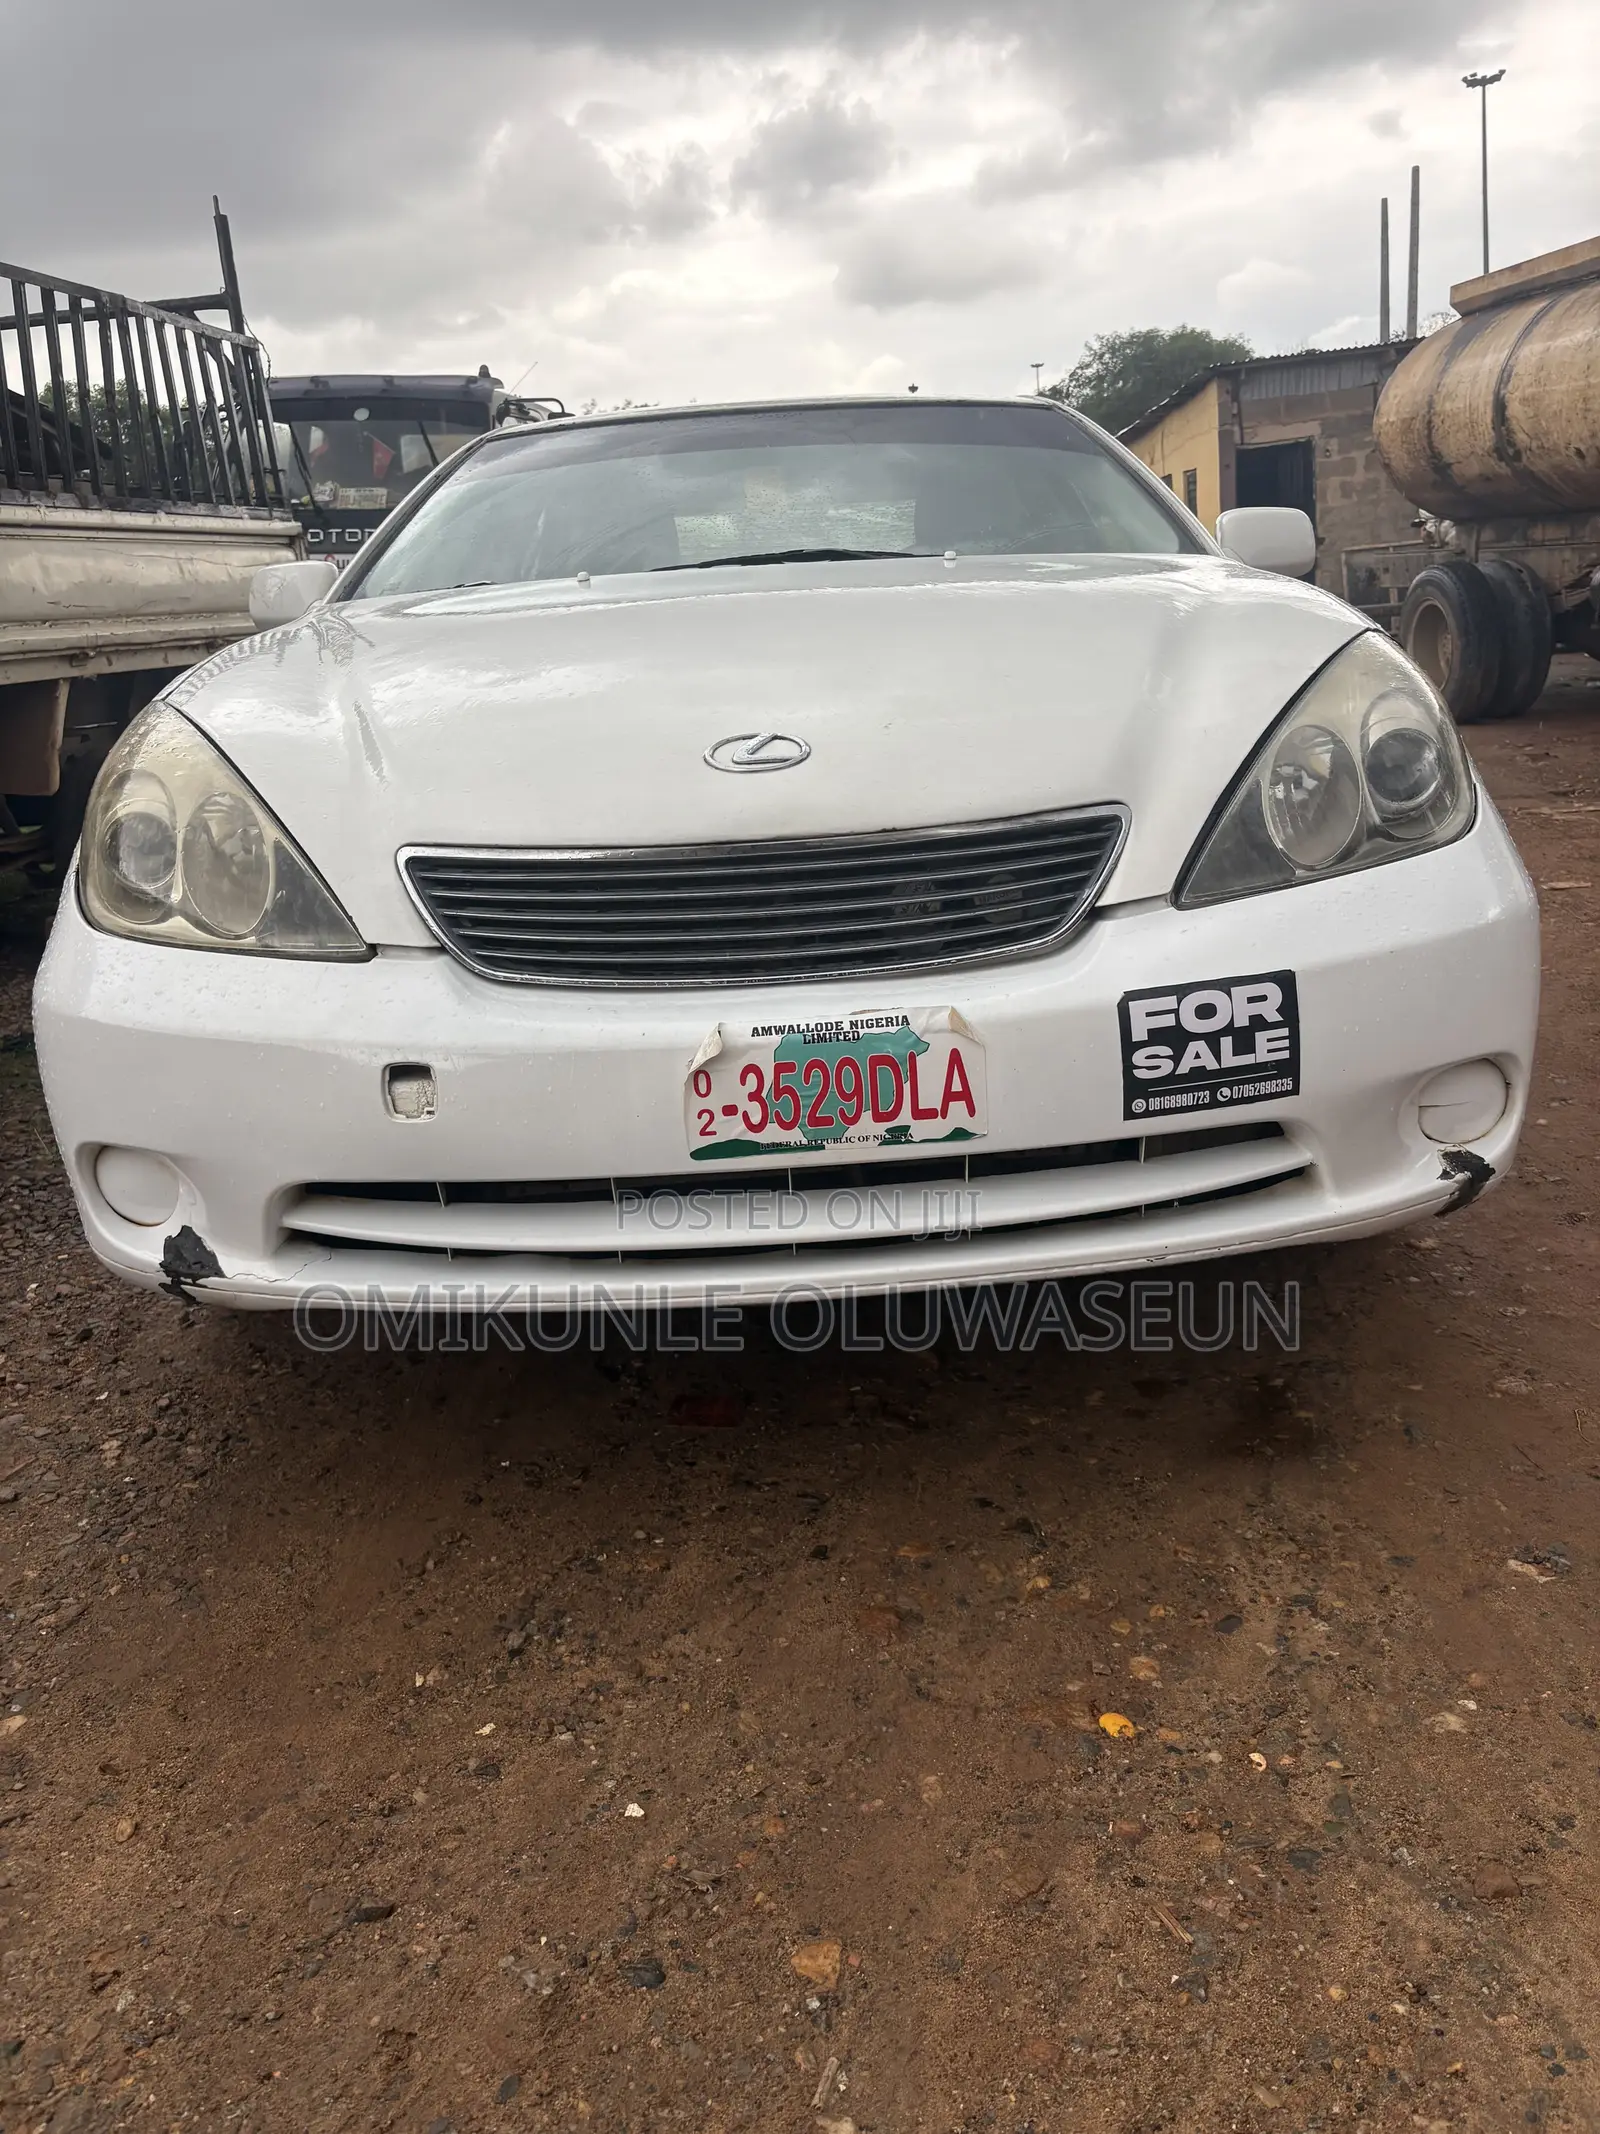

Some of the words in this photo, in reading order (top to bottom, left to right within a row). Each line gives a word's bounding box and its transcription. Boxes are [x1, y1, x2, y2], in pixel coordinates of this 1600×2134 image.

[751, 1021, 844, 1037] AMWALLODE
[849, 1015, 911, 1031] NIGERIA
[1128, 982, 1284, 1042] FOR
[802, 1031, 861, 1045] LIMITED
[1131, 1027, 1290, 1079] SALE
[1148, 1090, 1210, 1112] 08168980723
[1232, 1077, 1293, 1099] 07052698335
[808, 1135, 856, 1147] REPUBLIC
[857, 1134, 871, 1143] OF
